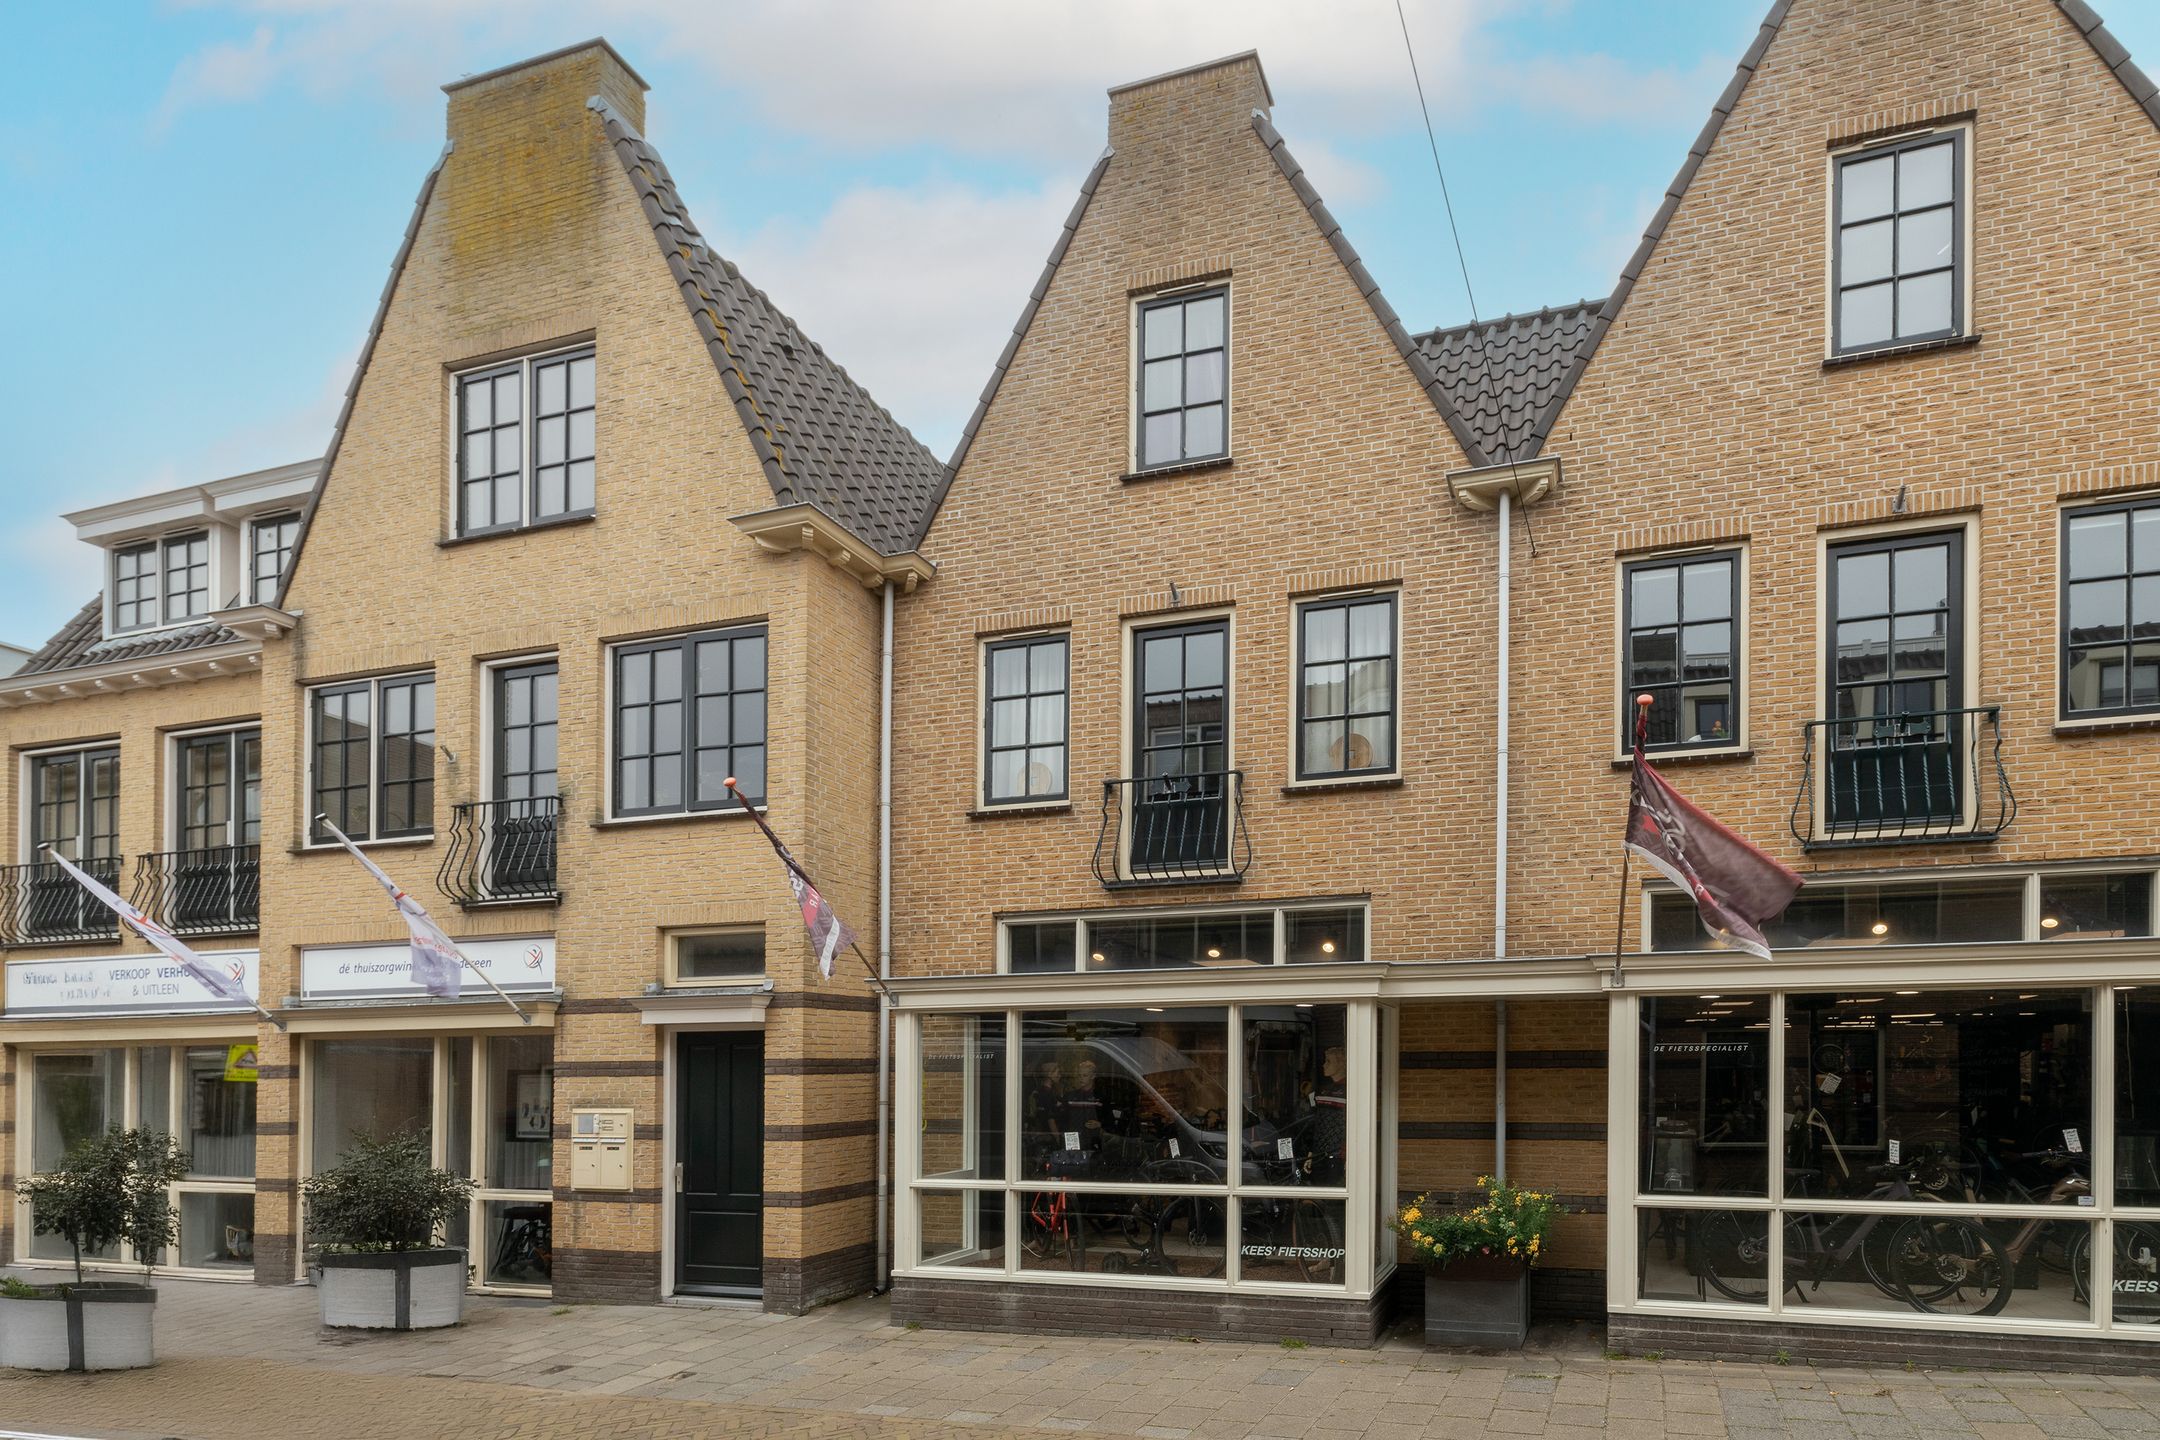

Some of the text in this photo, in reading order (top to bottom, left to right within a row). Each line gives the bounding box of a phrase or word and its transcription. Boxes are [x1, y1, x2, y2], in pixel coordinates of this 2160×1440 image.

[109, 968, 150, 981] VERKOOP
[354, 961, 412, 975] thuiszorgwin
[132, 983, 180, 996] & UITLEEN
[1278, 1246, 1345, 1259] FIETSSHOP
